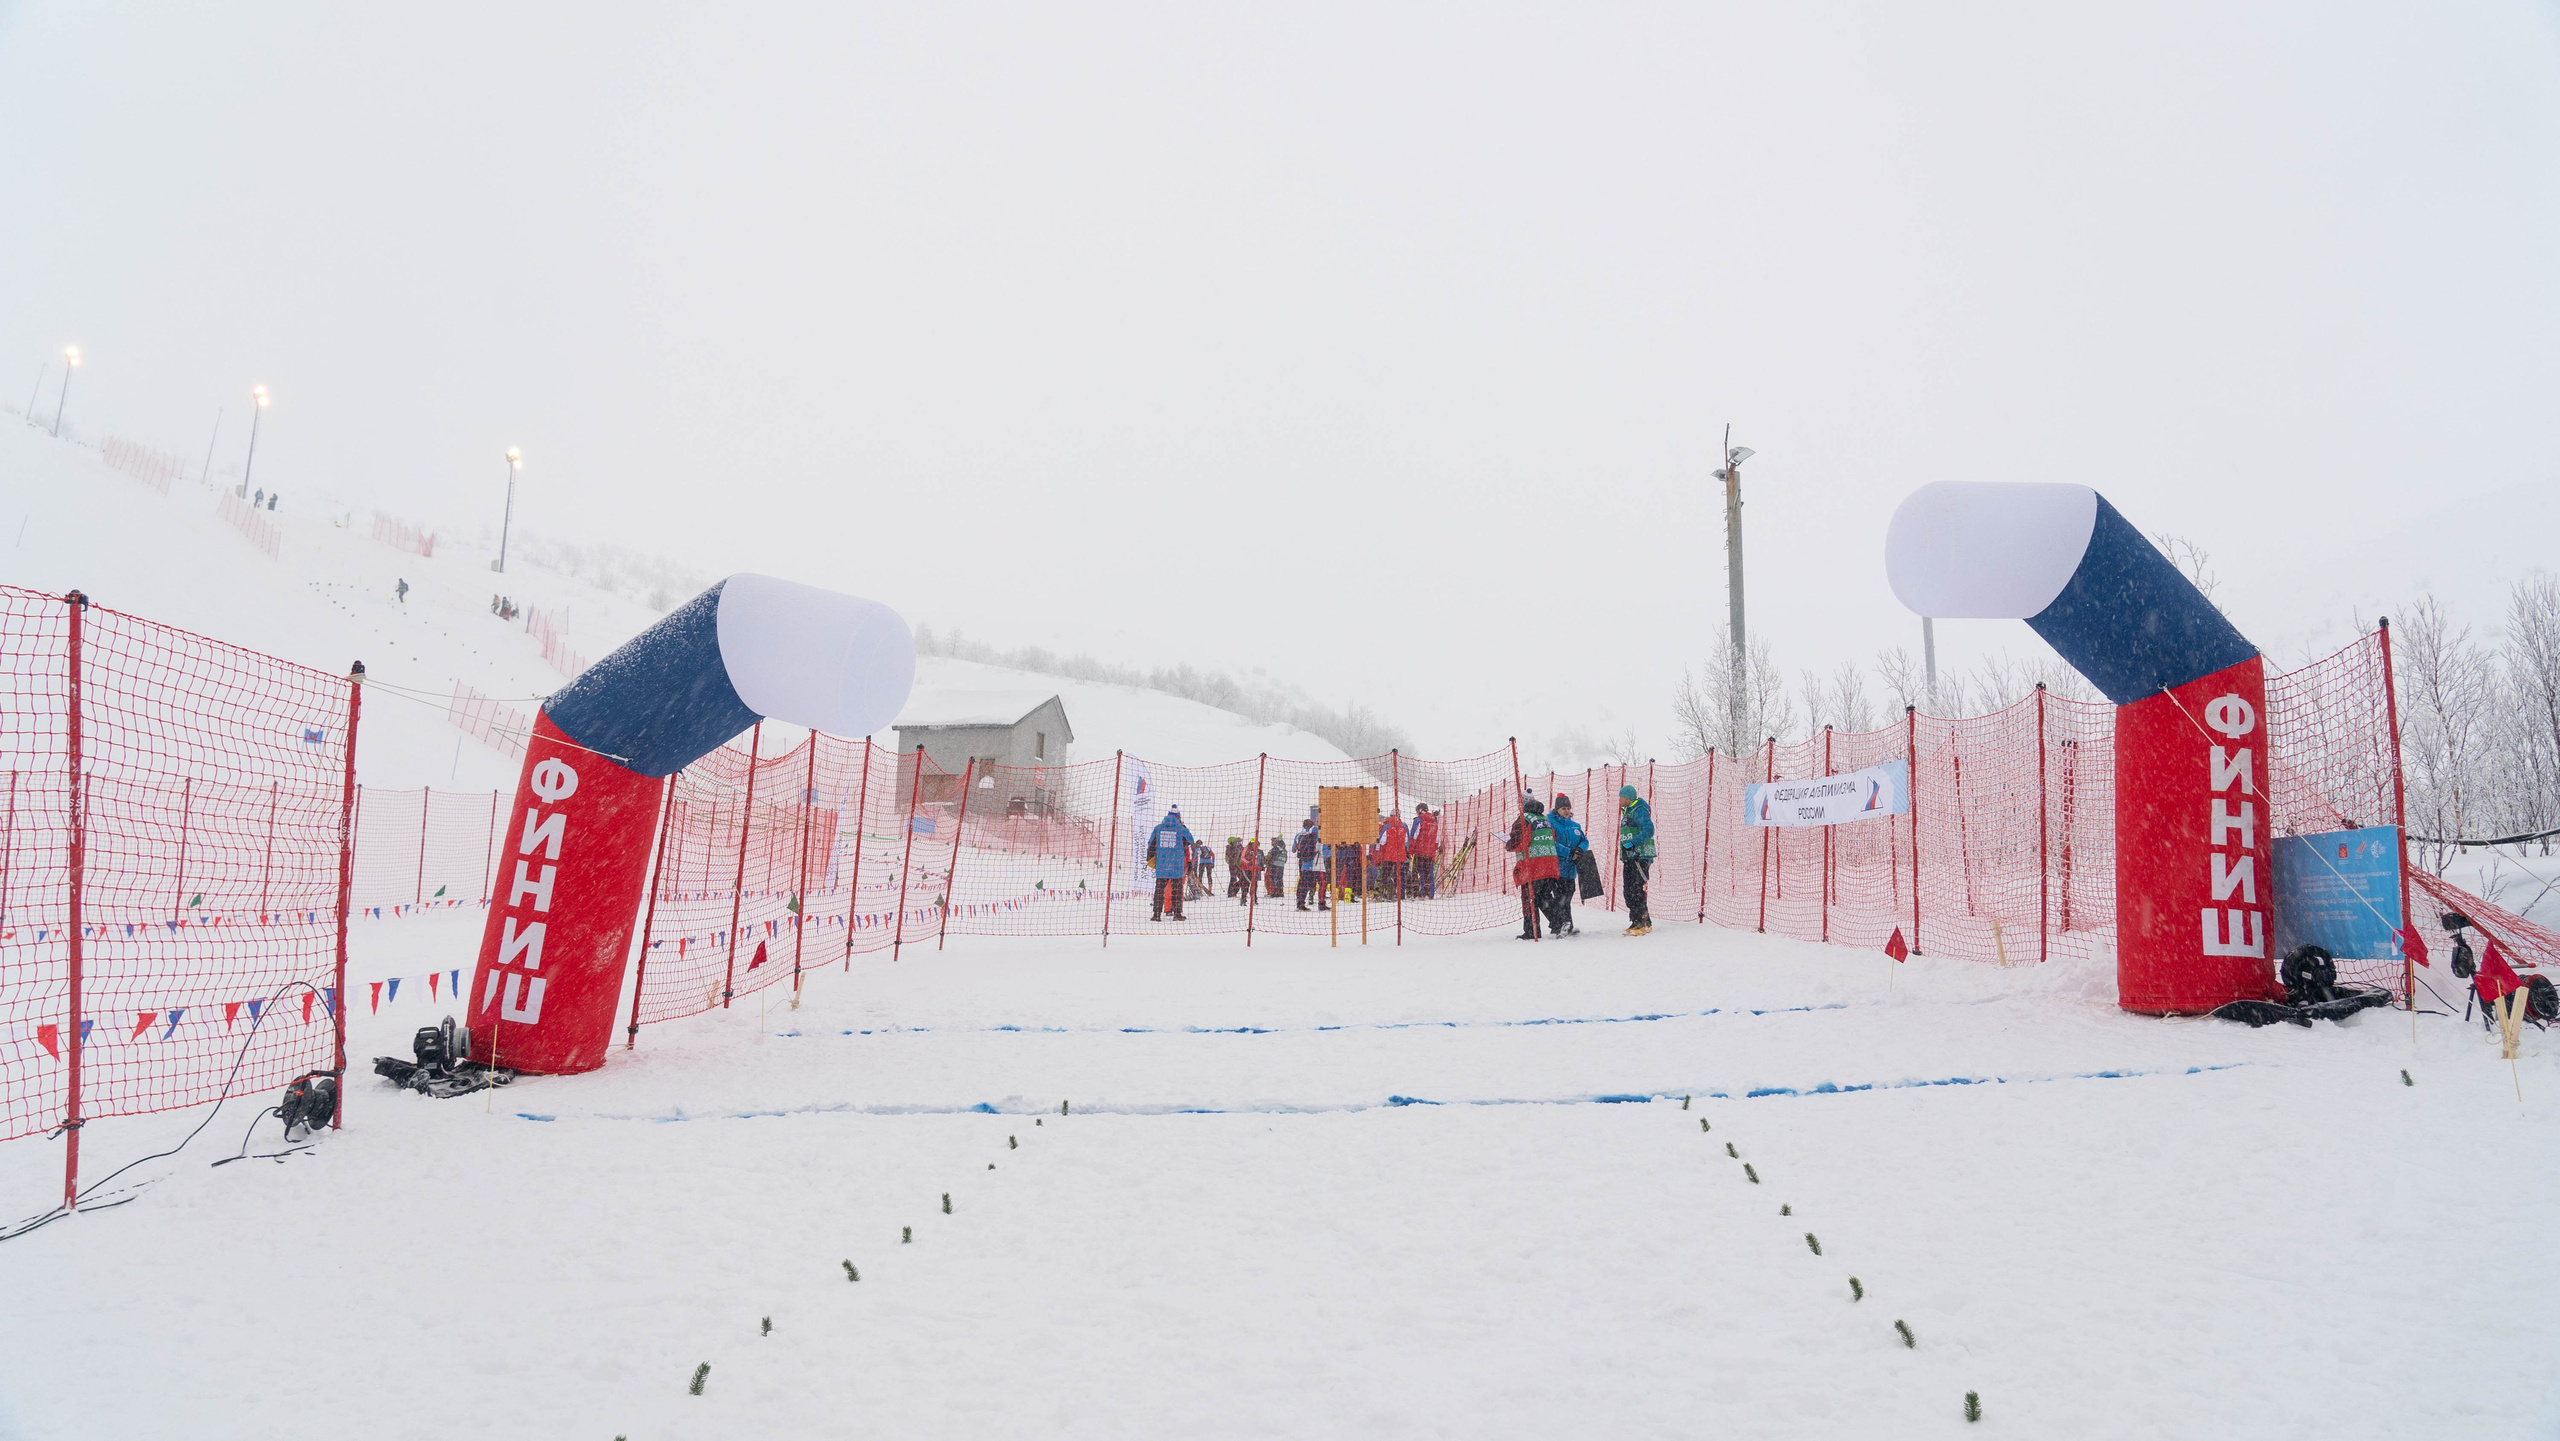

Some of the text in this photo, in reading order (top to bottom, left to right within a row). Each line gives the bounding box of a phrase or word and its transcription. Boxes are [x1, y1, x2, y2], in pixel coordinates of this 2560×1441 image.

[481, 757, 579, 1025] ФИНИШ
[1798, 806, 1826, 820] РОССИИ
[2201, 692, 2265, 959] ФИНИШ
